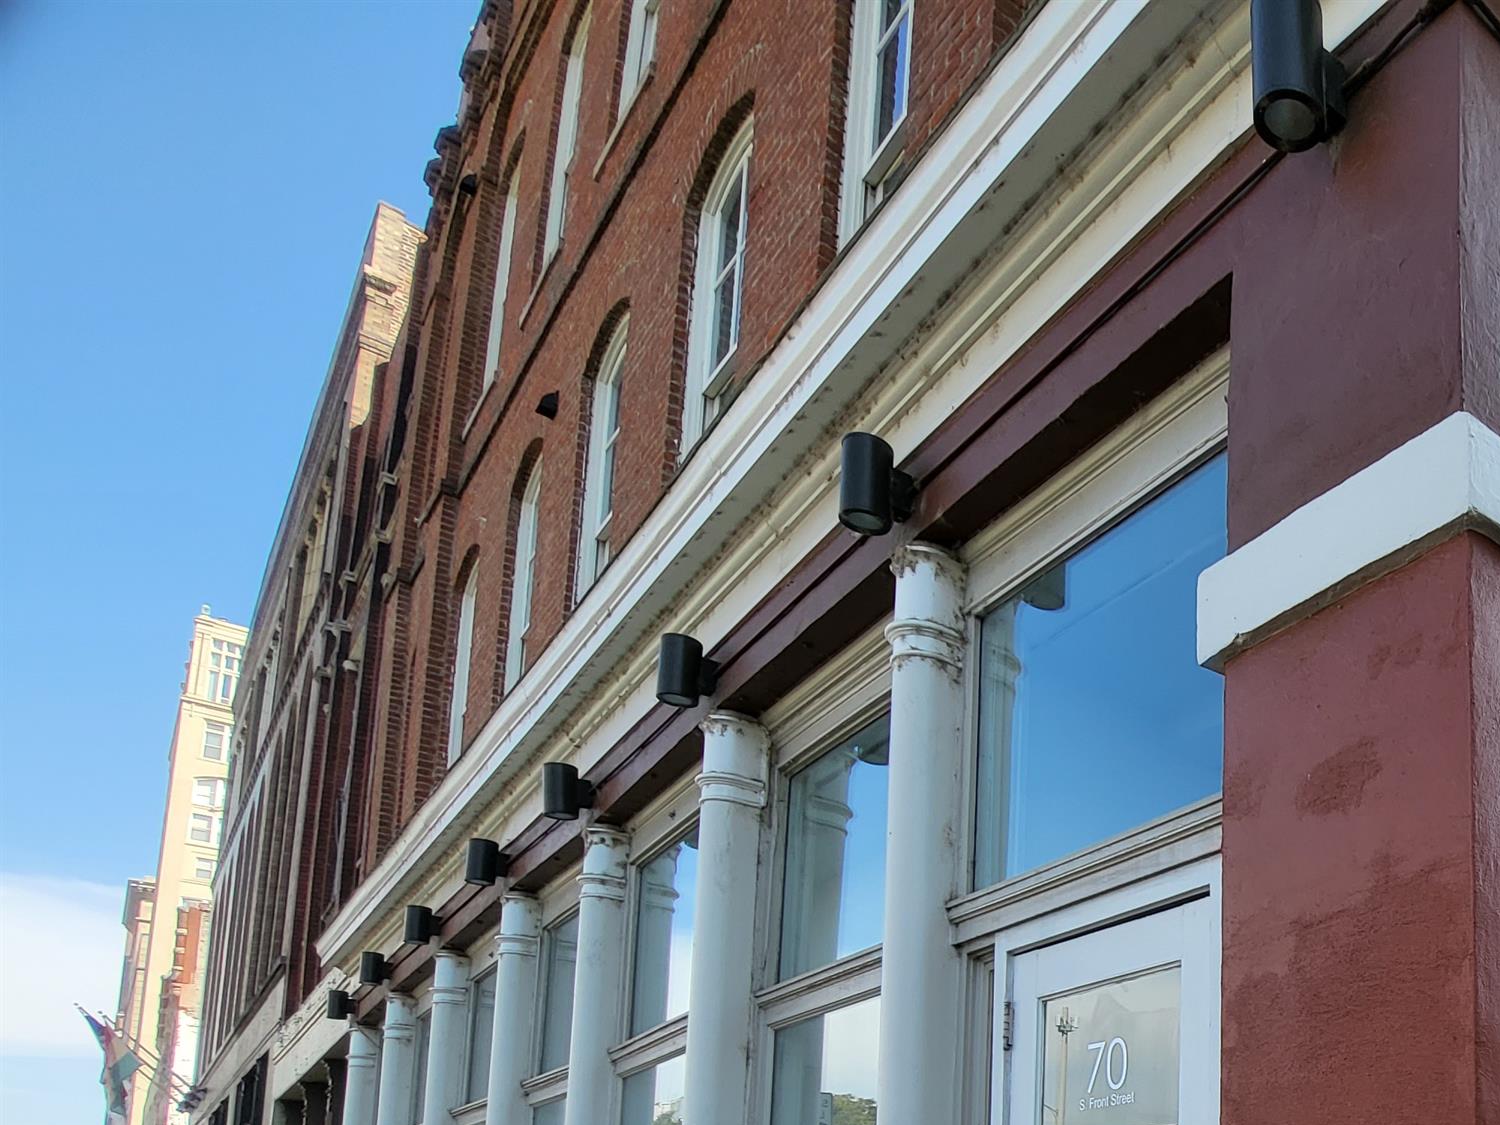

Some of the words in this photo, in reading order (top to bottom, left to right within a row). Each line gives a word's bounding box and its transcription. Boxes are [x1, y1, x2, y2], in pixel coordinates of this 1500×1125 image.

[1087, 1037, 1127, 1093] 70
[1089, 1096, 1109, 1109] Front
[1110, 1092, 1135, 1106] Street
